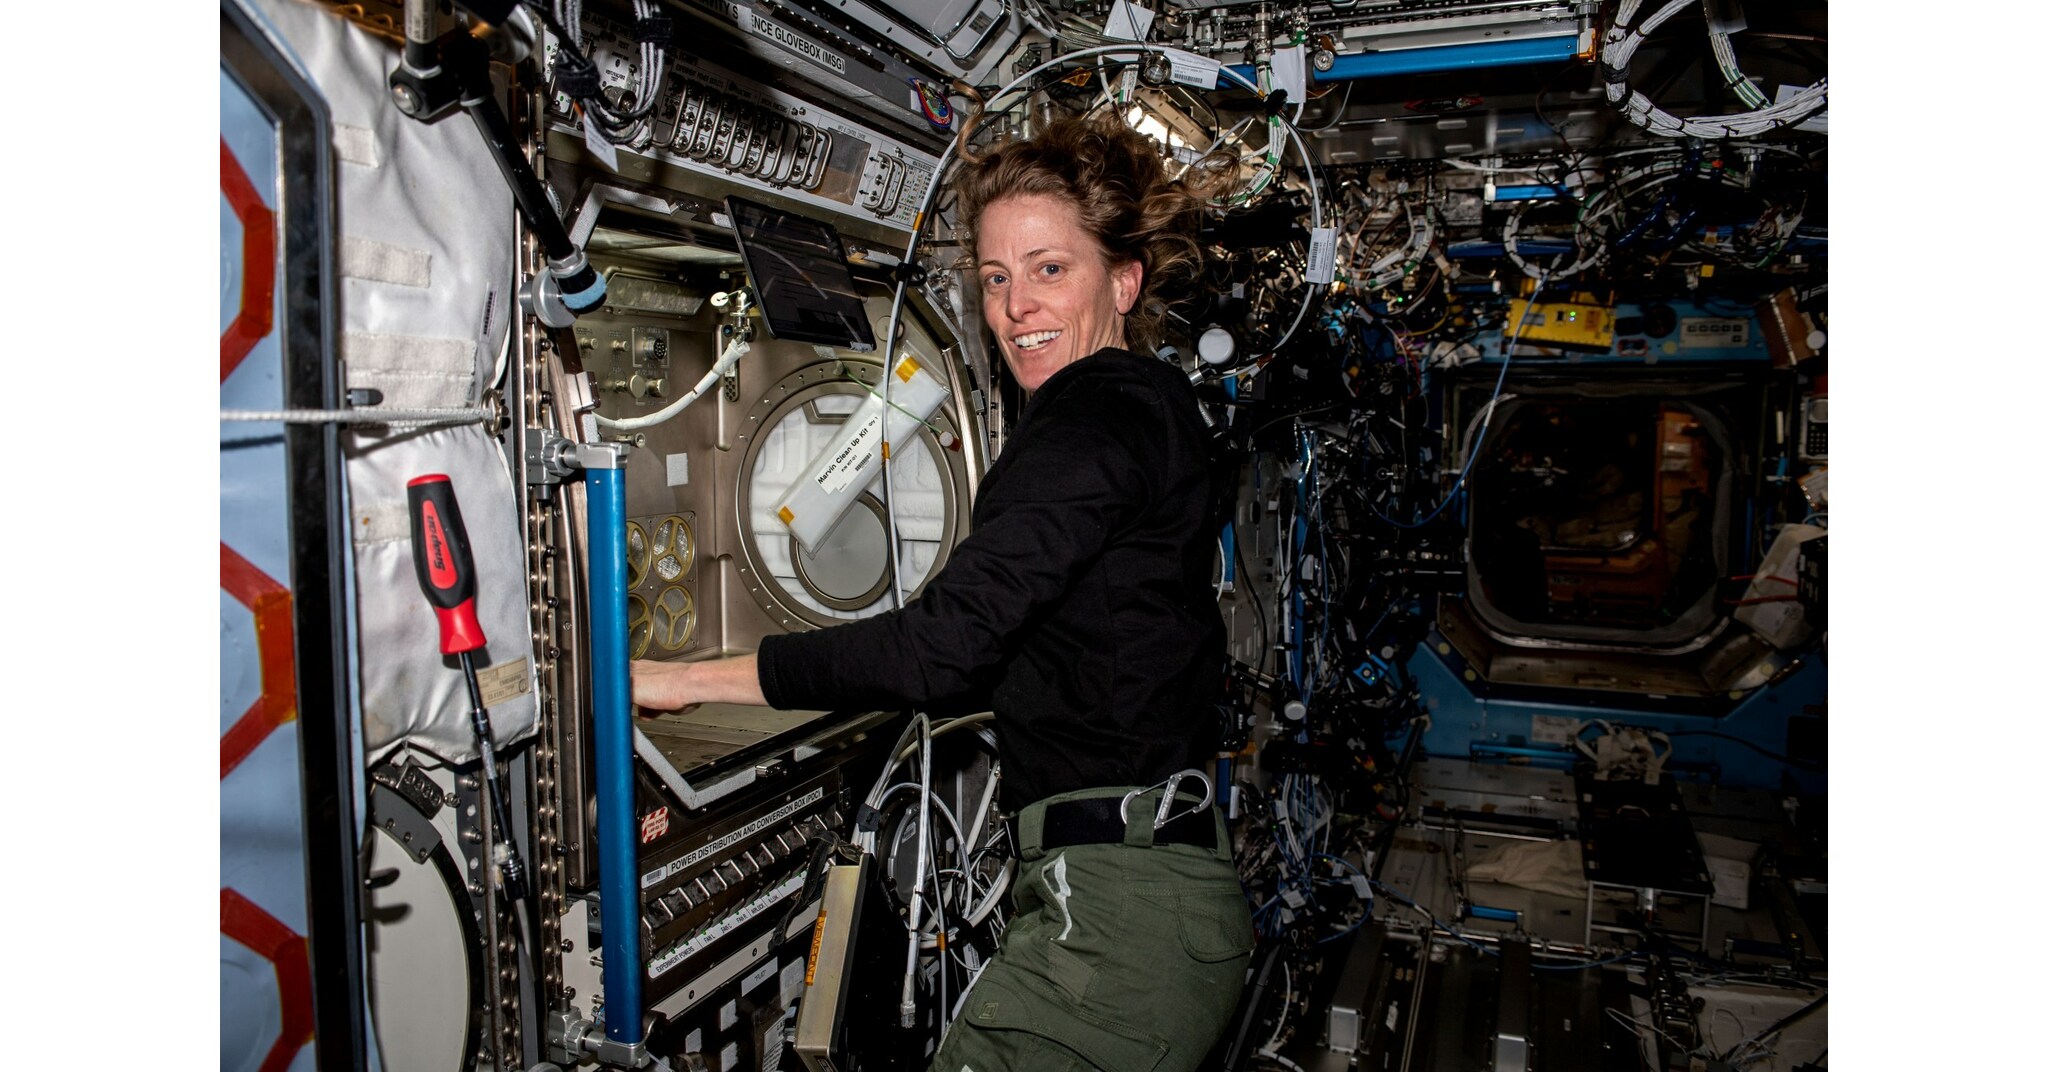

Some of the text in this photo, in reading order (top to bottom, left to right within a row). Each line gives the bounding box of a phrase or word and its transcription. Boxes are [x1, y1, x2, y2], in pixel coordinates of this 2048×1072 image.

[775, 27, 821, 60] GLOVEBOX
[822, 51, 845, 72] (MSG)
[817, 463, 836, 486] Marvin
[835, 446, 853, 465] Clean
[851, 437, 861, 449] Up
[859, 427, 869, 439] Kit
[671, 790, 822, 872] POWER DISTRIBUTION AND CONVERSION BOX (PDC)
[656, 946, 695, 974] EXPERIMENT POWERS
